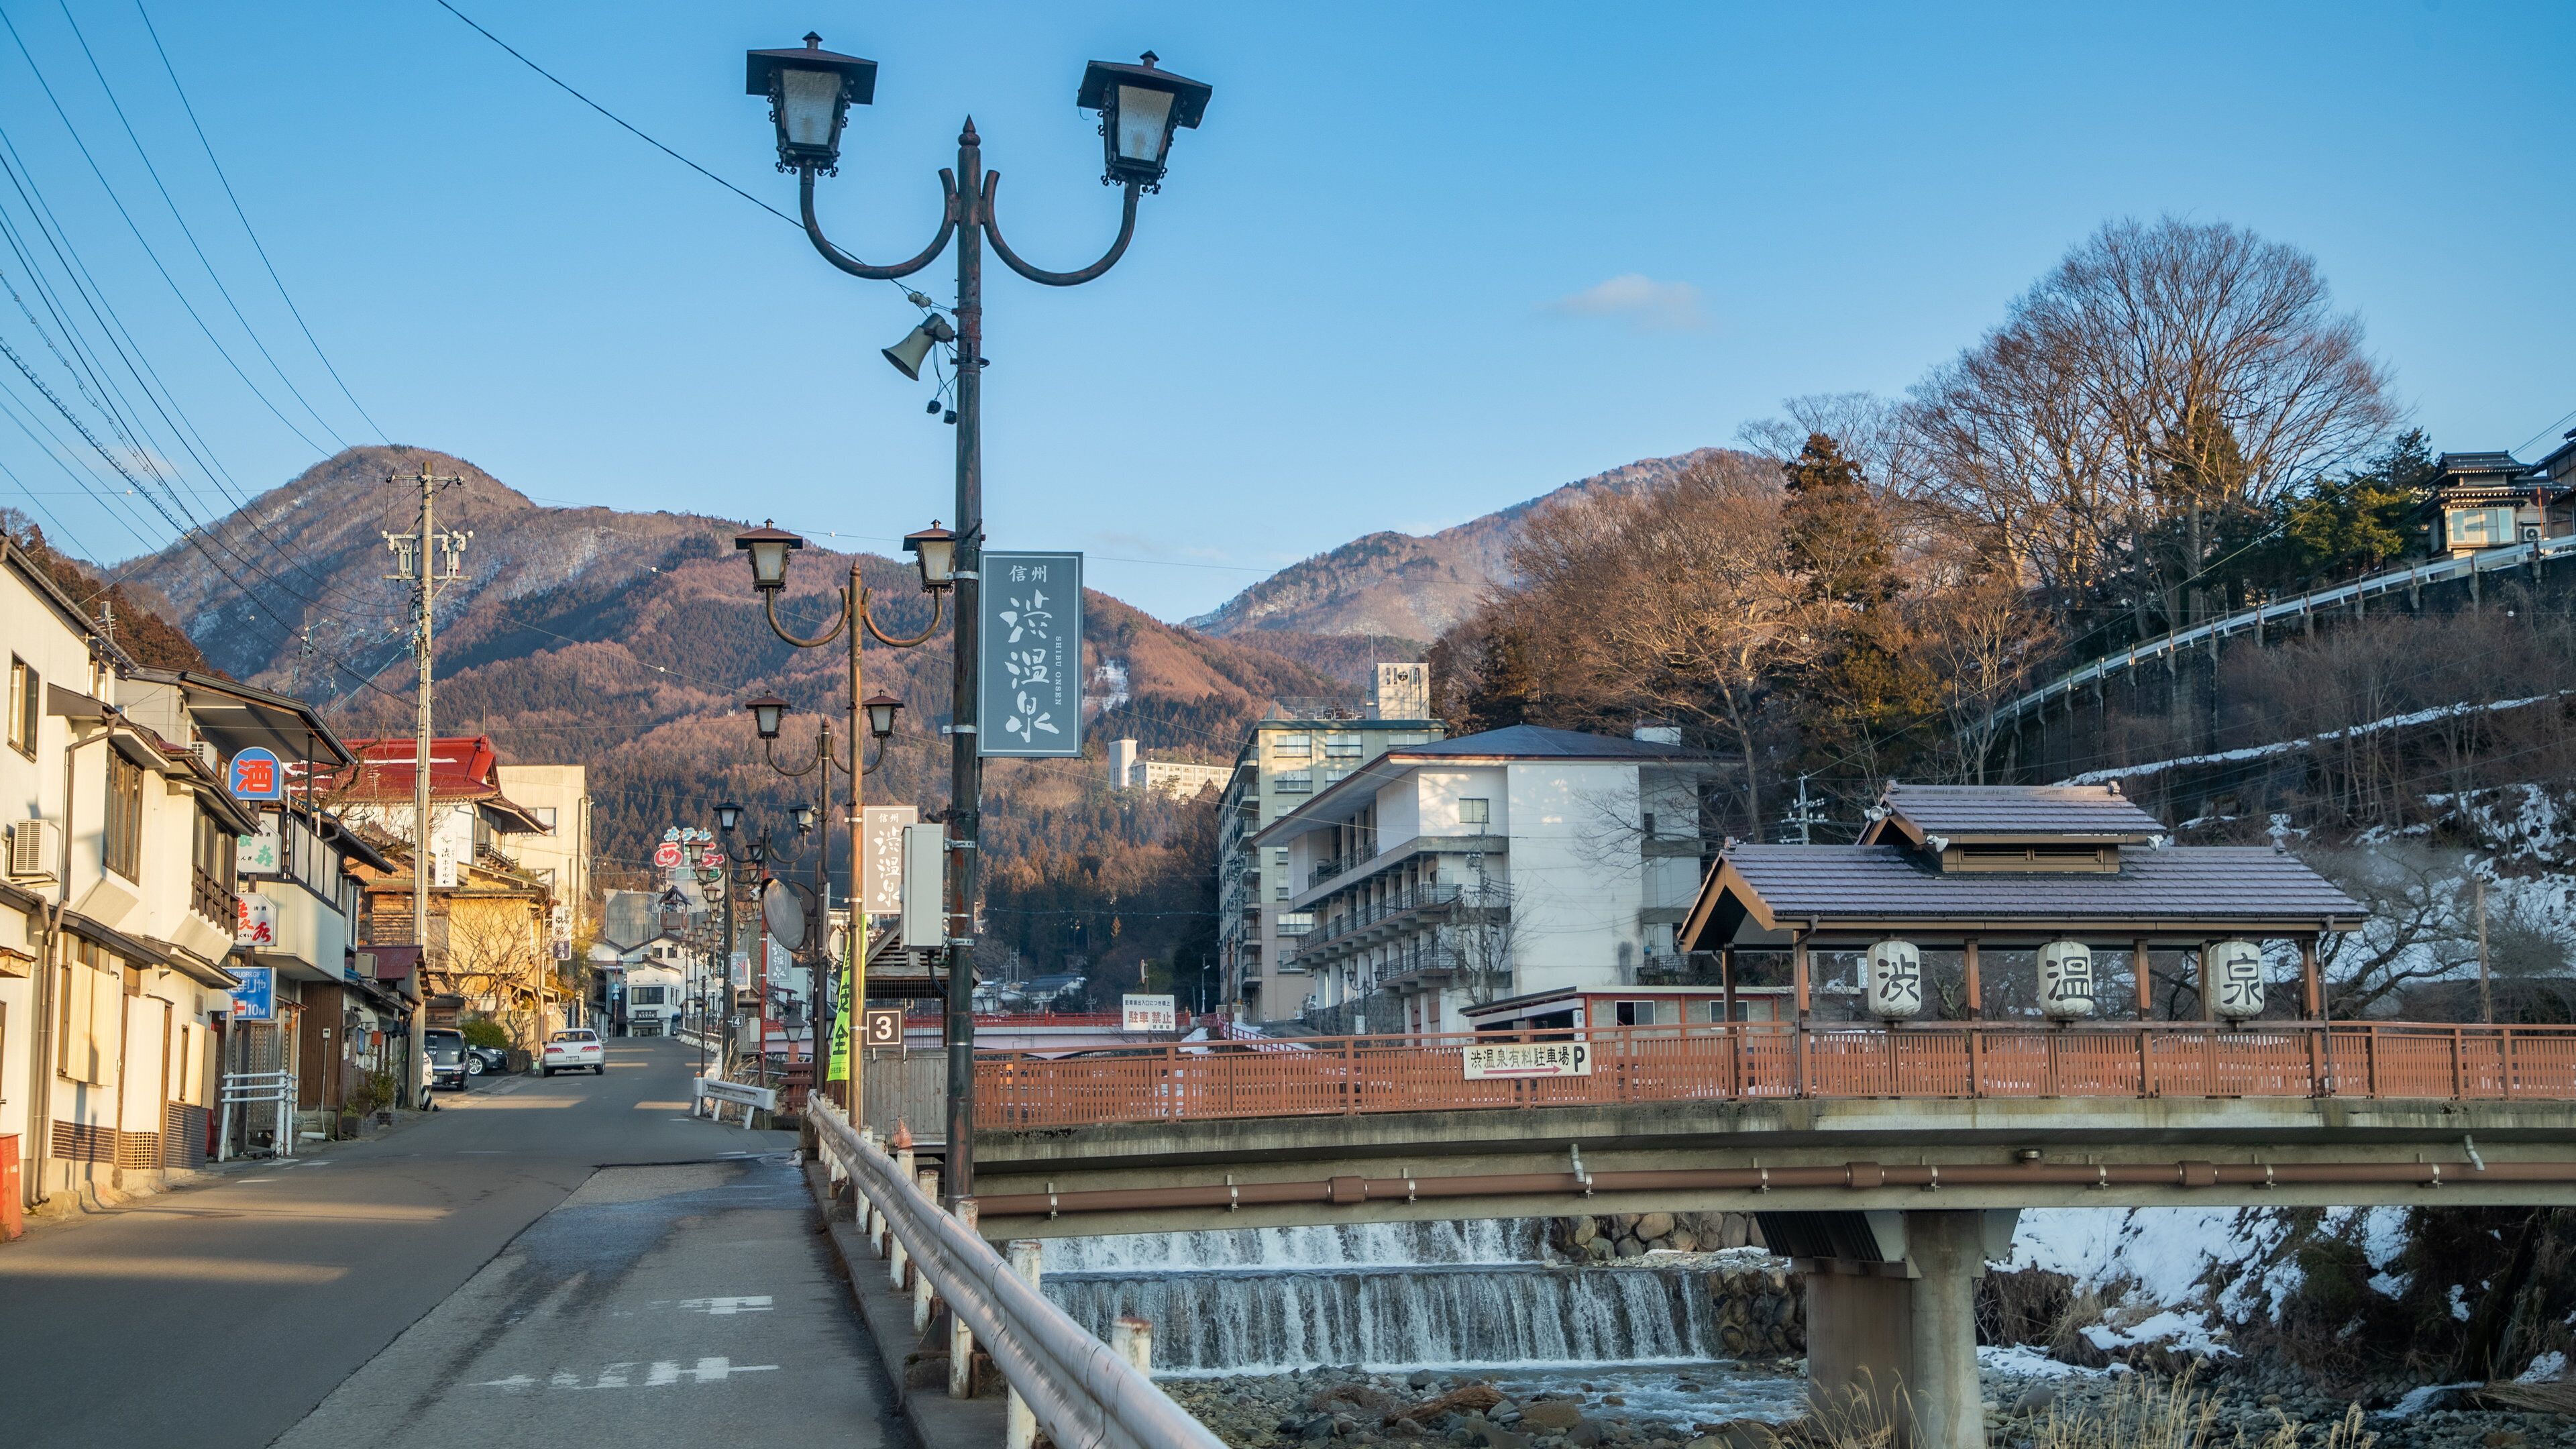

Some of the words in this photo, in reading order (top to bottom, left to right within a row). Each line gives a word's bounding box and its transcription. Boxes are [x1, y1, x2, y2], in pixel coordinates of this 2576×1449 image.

[1009, 564, 1047, 583] 信州
[999, 589, 1059, 743] 渋温泉
[237, 759, 273, 793] 酒
[878, 813, 899, 822] 信州
[664, 826, 712, 841] ホテル
[441, 847, 450, 877] 渋ホテル
[873, 826, 902, 907] 渋温泉
[1877, 953, 1920, 1002] 渋
[2047, 957, 2094, 1002] 温
[2223, 953, 2263, 1006] 泉
[248, 1004, 266, 1016] 10M
[1128, 1011, 1172, 1024] 駐車禁止
[875, 1016, 892, 1040] 3
[1470, 1046, 1570, 1069] 渋温泉有料駐車場
[1574, 1046, 1585, 1073] P
